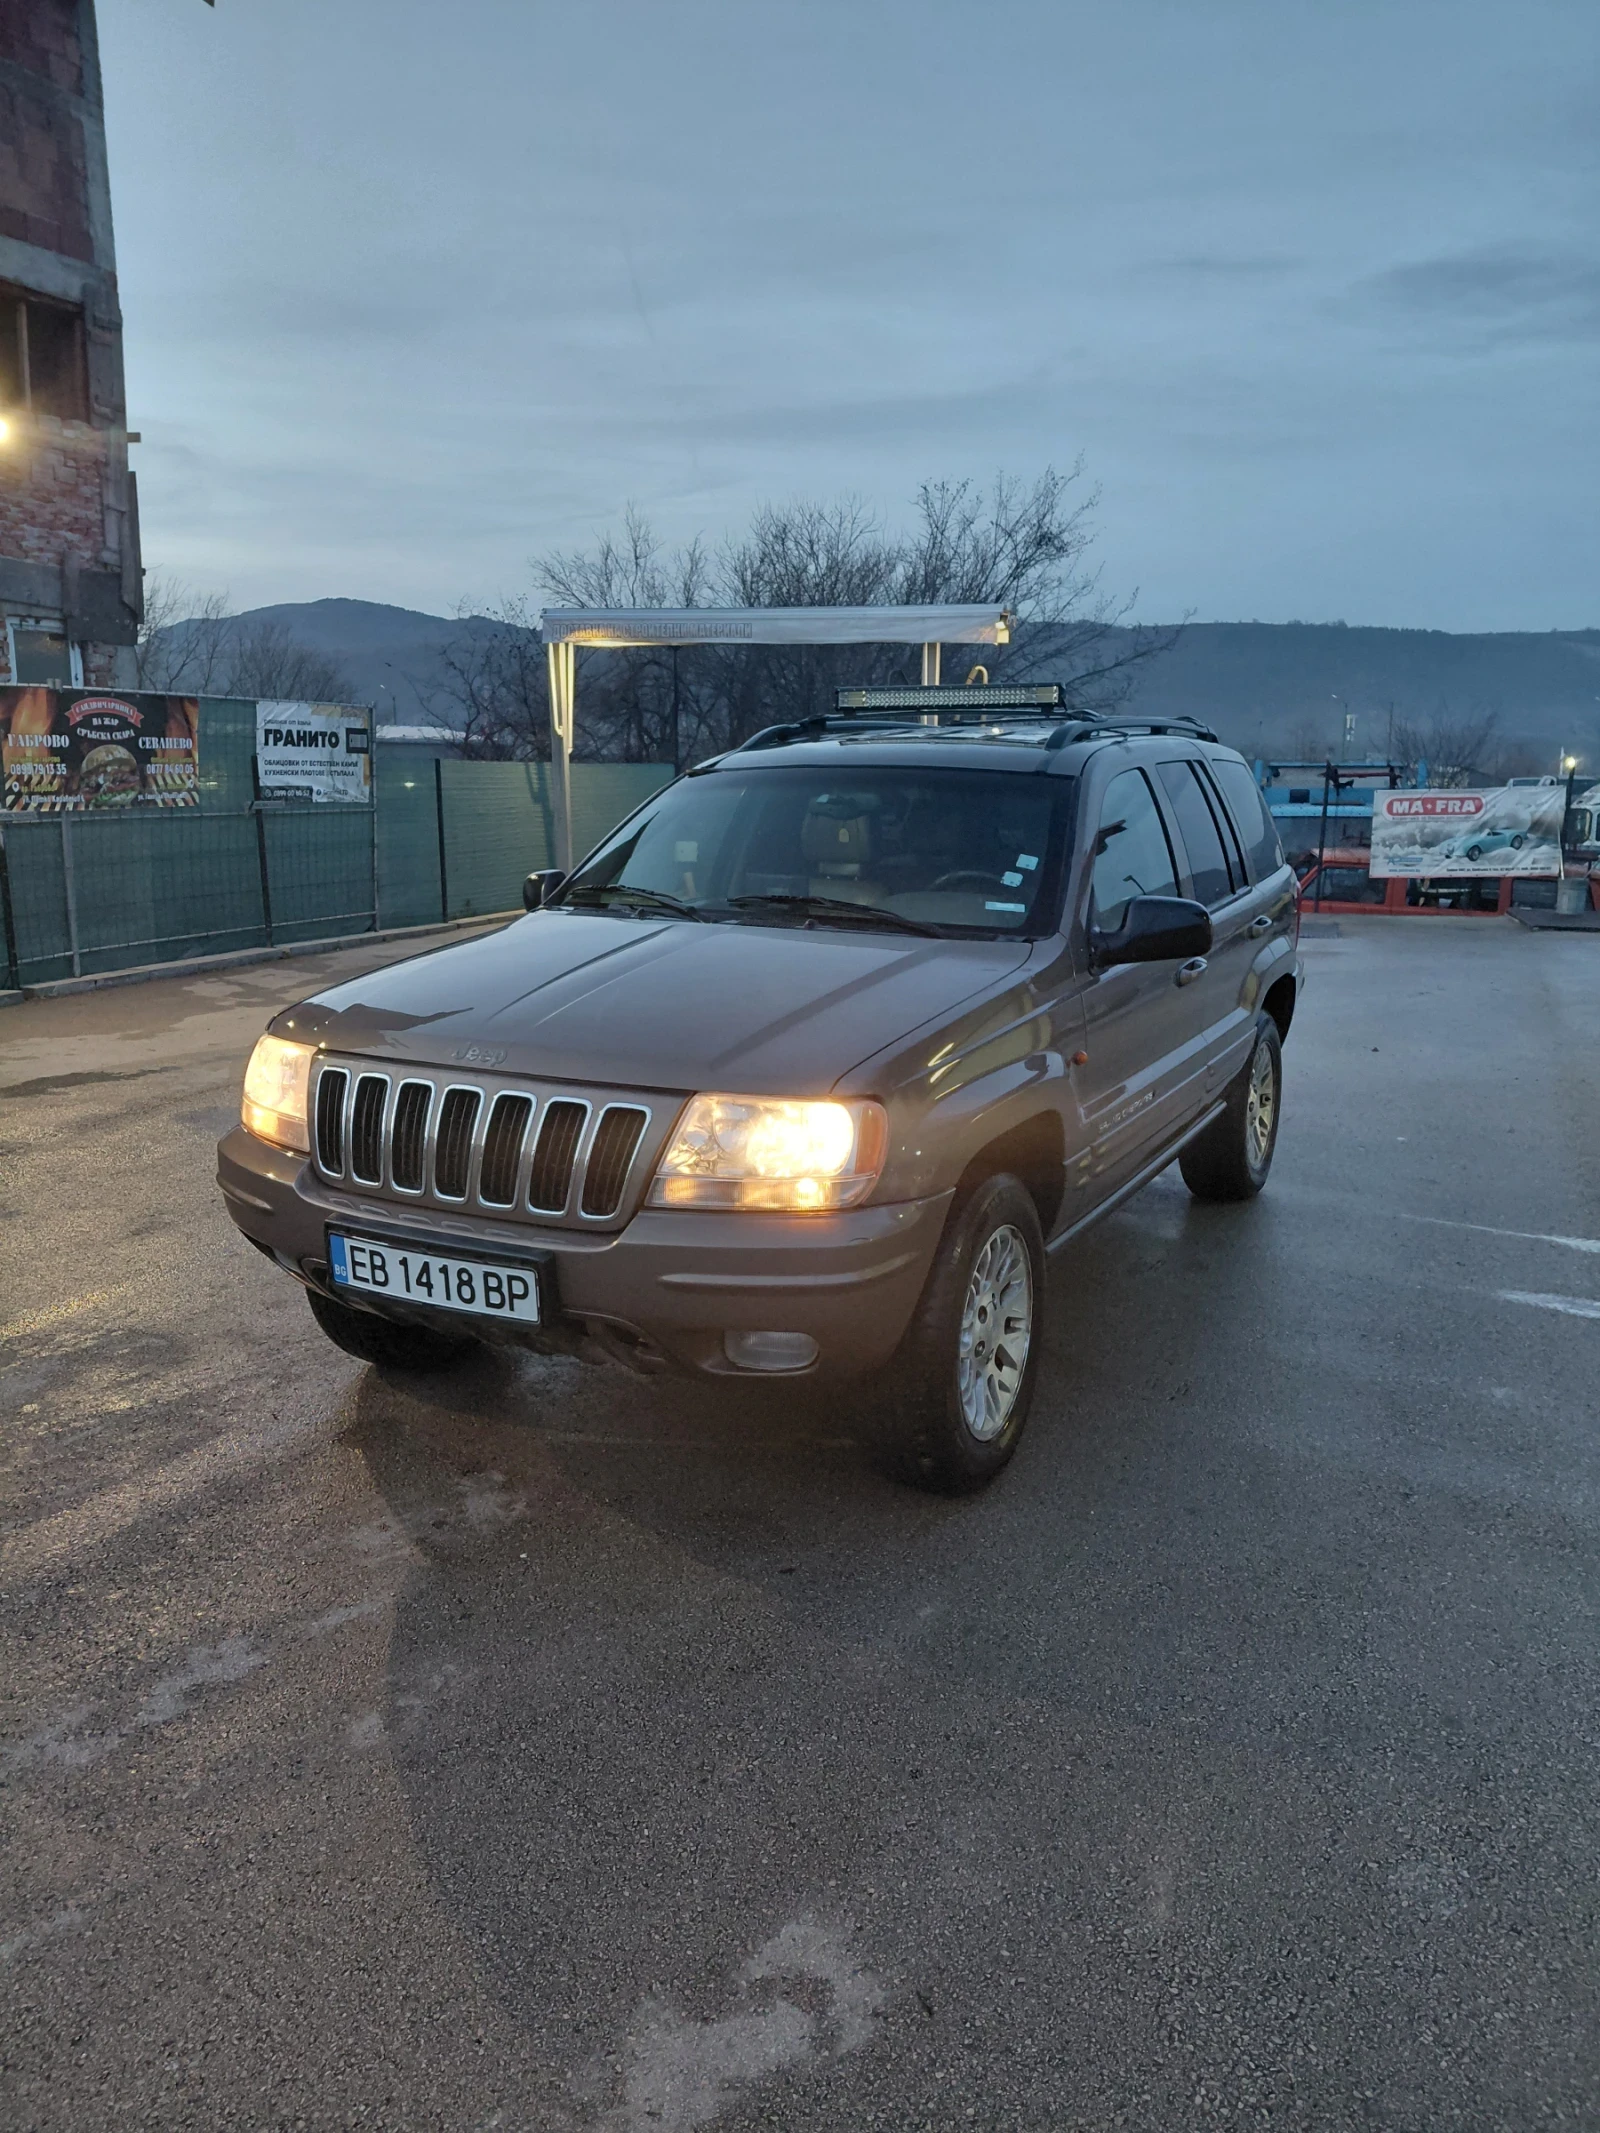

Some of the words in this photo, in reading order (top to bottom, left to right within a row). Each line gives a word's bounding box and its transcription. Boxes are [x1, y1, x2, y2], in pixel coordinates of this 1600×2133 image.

[553, 622, 605, 639] ДОСТАВКА
[607, 623, 622, 638] НА
[622, 622, 688, 638] СТРОИТЕЛНИ
[689, 622, 753, 638] МАТЕРИАЛИ
[103, 718, 119, 726] ЖАР
[7, 733, 70, 748] ГАБРОВО
[77, 727, 111, 740] СРЪБСКА
[112, 729, 135, 740] СКАРА
[264, 729, 340, 749] ГРАНИТО
[138, 737, 193, 749] СЕВЛИЕВО
[45, 764, 55, 775] 13
[56, 764, 67, 775] 35
[264, 760, 299, 768] ОБЛИЦОВКИ
[1436, 799, 1476, 813] FRA
[451, 1042, 508, 1067] Jeep
[334, 1263, 347, 1277] BG
[349, 1245, 389, 1287] EB
[399, 1256, 476, 1305] 1418
[482, 1270, 530, 1312] BP
